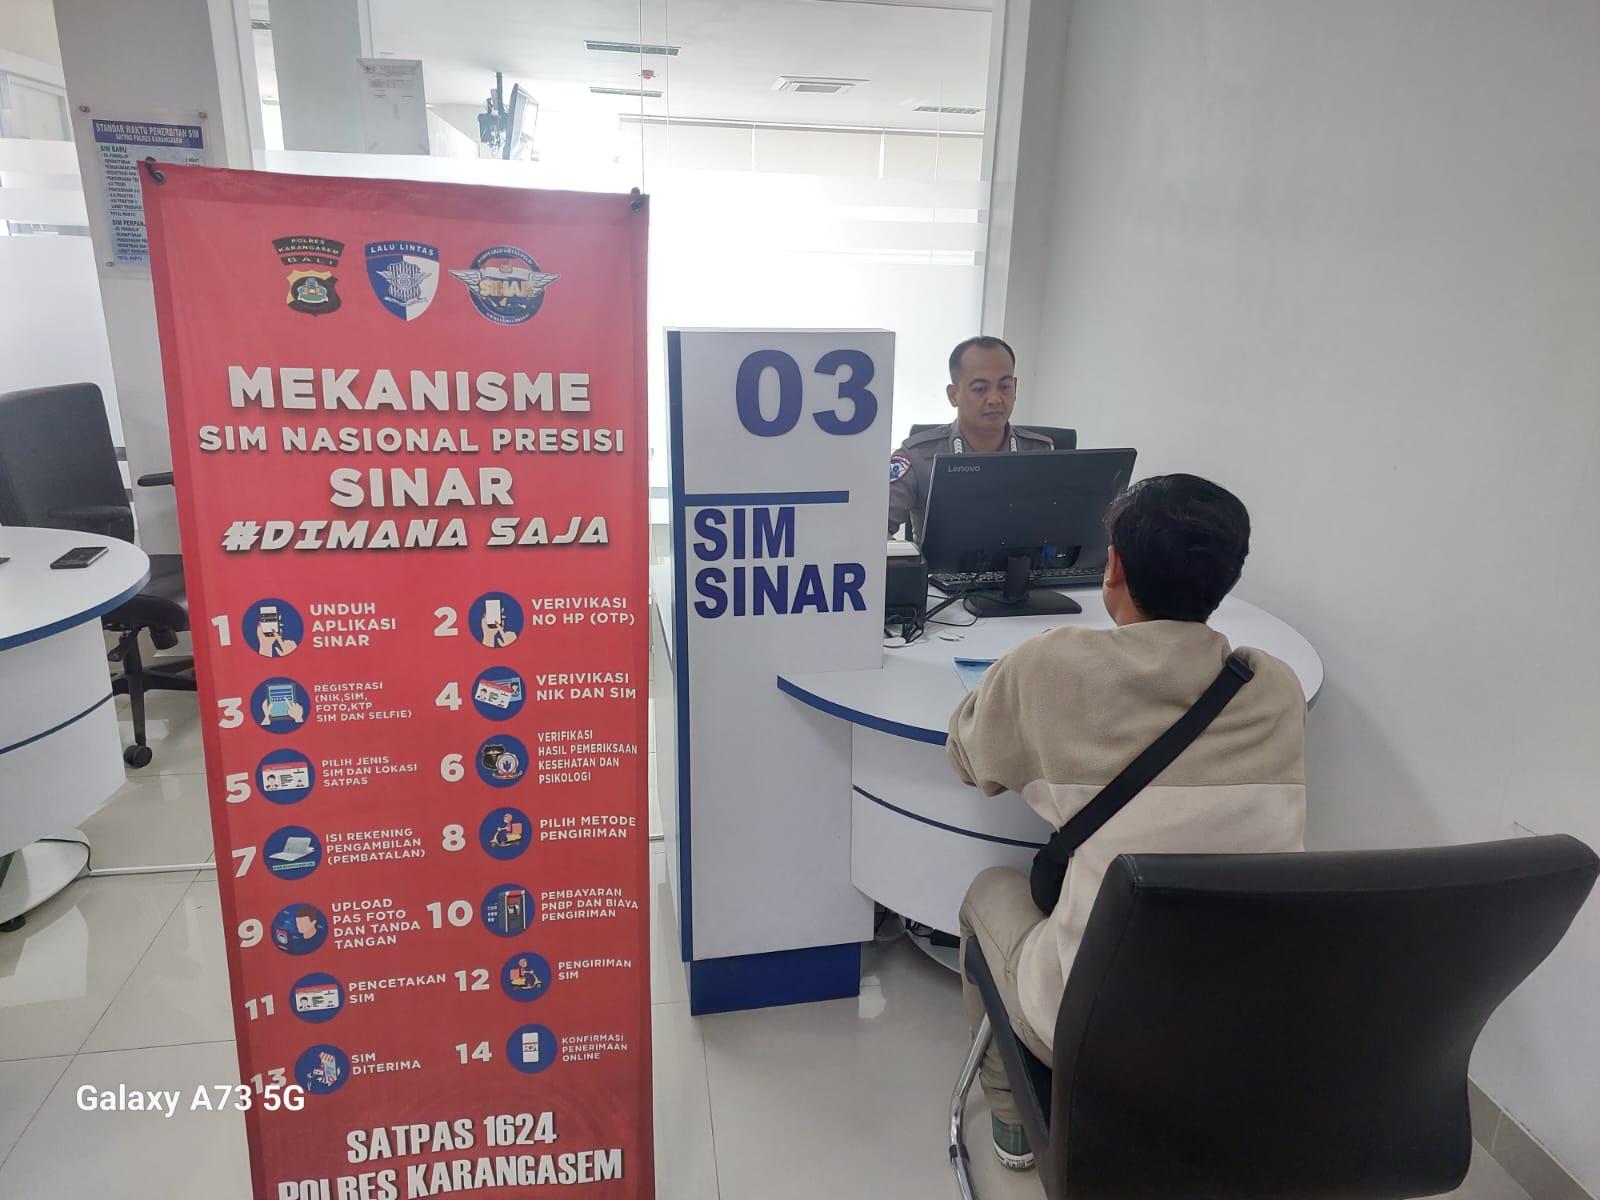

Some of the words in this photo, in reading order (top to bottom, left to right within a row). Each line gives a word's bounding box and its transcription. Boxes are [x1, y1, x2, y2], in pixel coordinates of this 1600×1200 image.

[370, 243, 395, 253] LALU
[399, 243, 434, 256] LINTAS
[228, 366, 590, 411] MEKANISME
[735, 349, 878, 437] 03
[200, 426, 266, 450] SIM
[282, 427, 478, 451] NASIONAL
[493, 429, 623, 451] PRESISI
[948, 464, 980, 473] Lenovo
[330, 467, 513, 507] SINAR
[222, 519, 467, 550] #DIMANA
[488, 517, 608, 545] SAJA
[693, 507, 795, 561] SIM
[694, 562, 866, 619] SINAR
[310, 603, 375, 615] UNDUH
[532, 597, 626, 610] VERIVIKASI
[312, 618, 395, 632] APLIKASI
[434, 607, 458, 636] 2
[533, 614, 556, 625] NO
[563, 612, 587, 624] HP
[591, 613, 634, 625] (OTP)
[212, 615, 230, 646] 1
[313, 635, 369, 647] SINAR
[536, 673, 628, 685] VERIVIKASI
[314, 682, 382, 692] REGISTRASI
[316, 693, 367, 702] (NIK,SIM,
[435, 682, 462, 710] 4
[537, 689, 564, 700] NIK
[571, 688, 604, 698] DAN
[611, 688, 635, 698] SIM
[218, 697, 244, 728] 3
[316, 702, 372, 712] FOTO,KTP
[317, 714, 337, 722] SIM
[341, 713, 364, 721] DAN
[369, 710, 411, 719] SELFIE)
[538, 730, 592, 742] VERIFIKASI
[539, 746, 566, 756] HASIL
[571, 744, 637, 754] PEMERIKSAAN
[322, 759, 352, 768] PILIH
[357, 757, 389, 765] JENIS
[441, 754, 464, 781] 6
[539, 758, 595, 770] KESEHATAN
[600, 757, 619, 767] DAN
[323, 768, 344, 777] SIM
[347, 766, 371, 775] DAN
[375, 763, 417, 774] LOKASI
[324, 777, 367, 786] SATPAS
[539, 772, 590, 784] PSIKOLOGI
[226, 772, 251, 803] 5
[541, 818, 576, 828] PILIH
[582, 816, 635, 826] METODE
[326, 834, 343, 842] ISI
[347, 829, 412, 840] REKENING
[443, 824, 465, 851] 8
[541, 828, 626, 840] PENGIRIMAN
[327, 838, 421, 853] PENGAMBILAN
[232, 846, 256, 877] 7
[328, 850, 425, 865] (PEMBATALAN)
[542, 888, 621, 900] PEMBAYARAN
[332, 899, 392, 912] UPLOAD
[542, 901, 572, 910] PNBP
[578, 898, 604, 909] DAN
[606, 899, 638, 909] BIAYA
[333, 914, 361, 924] PAS
[367, 910, 405, 921] FOTO
[427, 900, 473, 928] 10
[542, 910, 615, 921] PENGIRIMAN
[238, 919, 263, 947] 9
[334, 925, 366, 937] DAN
[371, 921, 420, 933] TANDA
[335, 935, 396, 949] TANGAN
[559, 959, 631, 969] PENGIRIMAN
[455, 969, 489, 991] 12
[559, 971, 578, 980] SIM
[349, 974, 445, 991] PENCETAKAN
[350, 993, 374, 1003] SIM
[245, 995, 274, 1020] 11
[562, 1035, 623, 1044] KONFIRMASI
[456, 1042, 492, 1064] 14
[563, 1044, 627, 1053] PENERIMAAN
[352, 1053, 375, 1063] SIM
[563, 1053, 600, 1061] ONLINE
[352, 1059, 422, 1075] DITERIMA
[251, 1067, 287, 1094] 13
[347, 1119, 473, 1163] SATPAS
[484, 1112, 556, 1146] 1624
[408, 1149, 621, 1199] KARANGASEM
